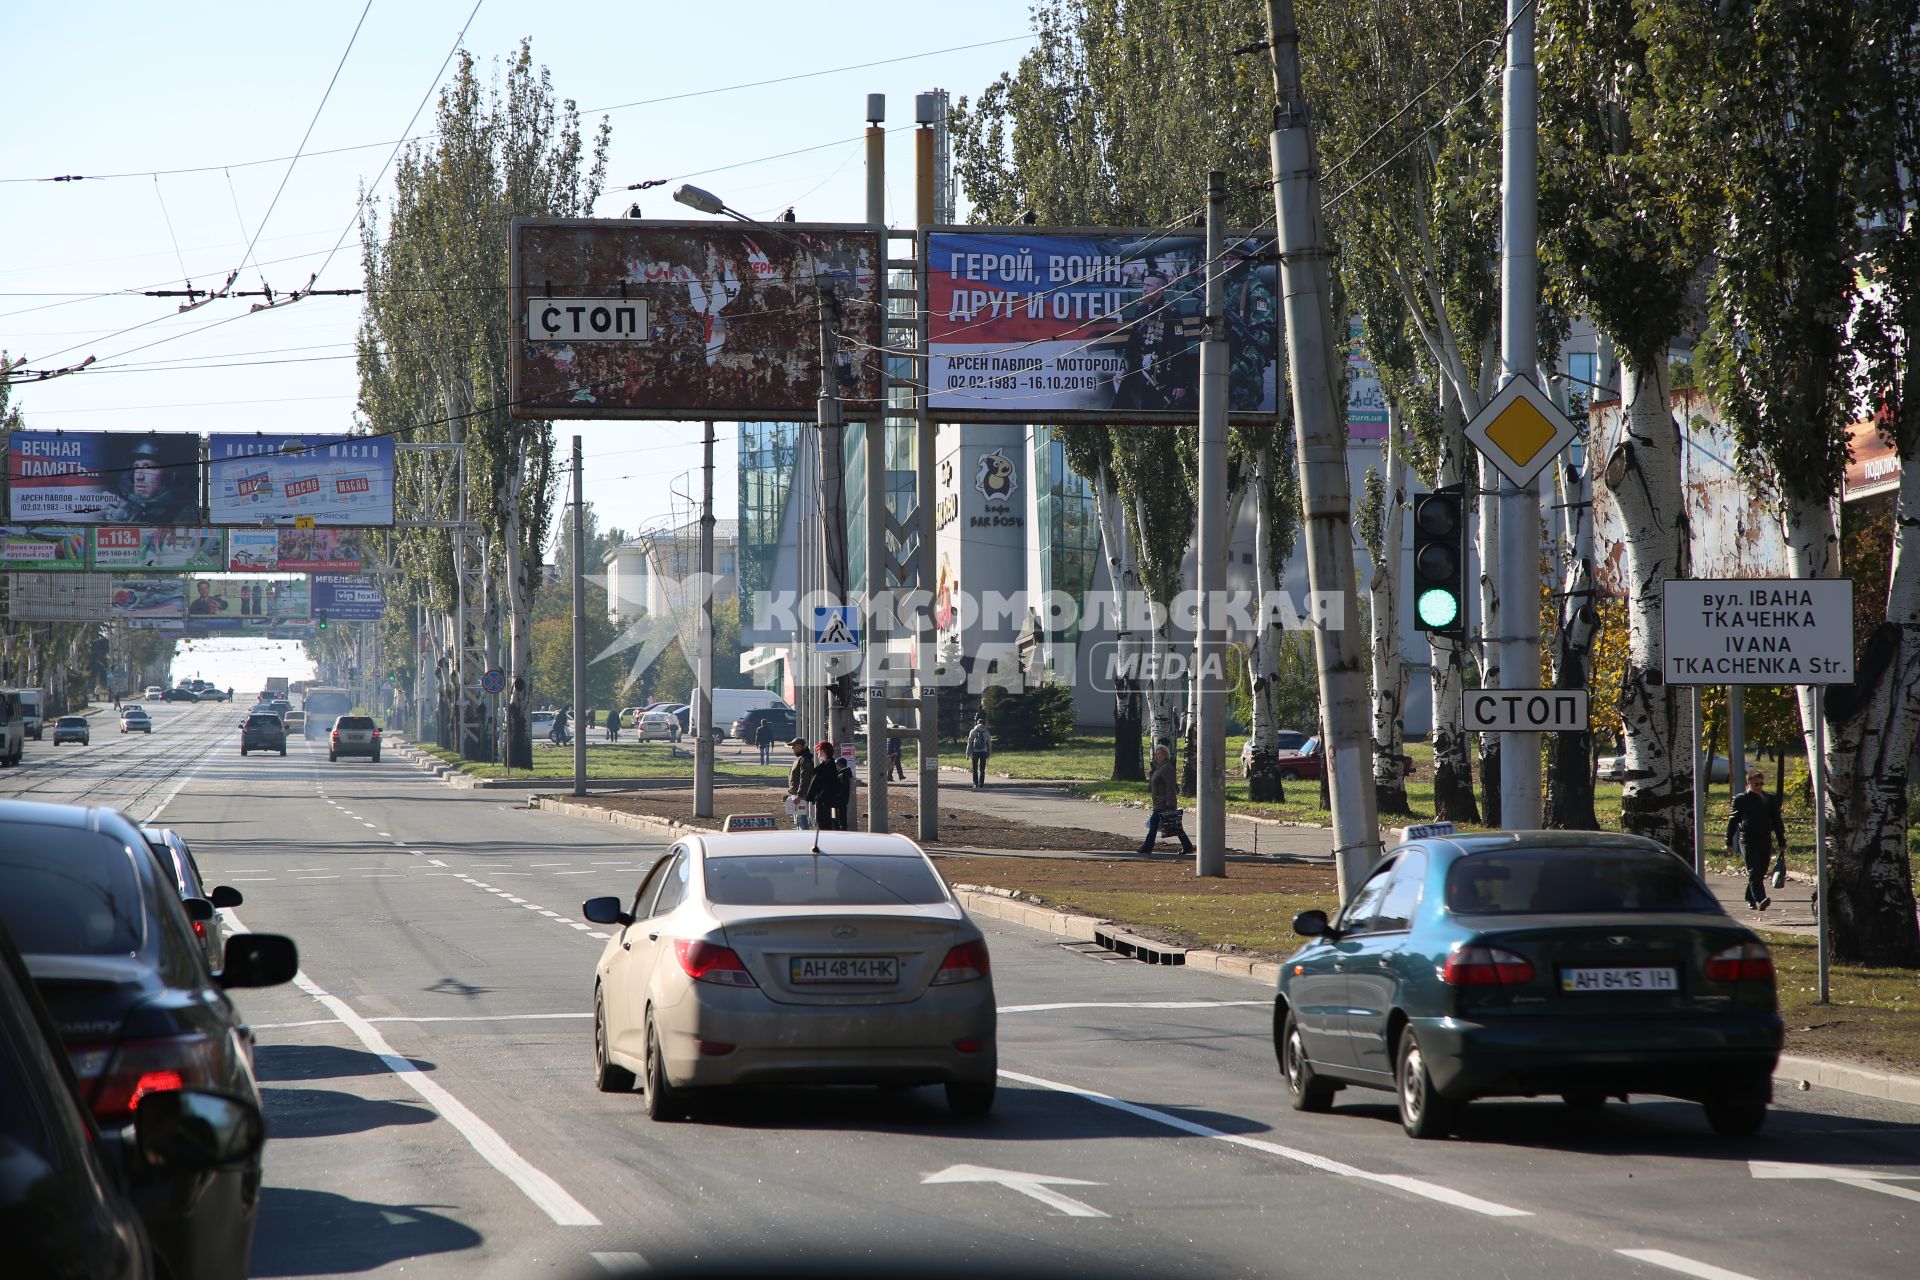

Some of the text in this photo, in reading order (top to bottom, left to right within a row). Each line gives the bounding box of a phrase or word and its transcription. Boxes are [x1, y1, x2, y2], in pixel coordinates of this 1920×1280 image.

[951, 248, 1128, 286] ГЕРОЙ, ВОИН,
[949, 289, 1123, 323] ДРУГ И ОТЕЦ
[541, 306, 636, 333] СТОП
[948, 358, 988, 372] АРСЕН
[991, 358, 1043, 372] ПАВЛОВ
[1057, 358, 1128, 373] МОТОРОЛА
[948, 376, 1017, 391] (02.02.1983
[22, 441, 81, 457] ВЕЧНАЯ
[329, 445, 379, 458] МАСЛО
[22, 461, 99, 477] ПАМЯТЬ...
[287, 478, 318, 497] МАСЛО
[338, 478, 367, 493] МАСЛО
[21, 494, 43, 502] АРСЕН
[45, 494, 72, 502] ПАВЛОВ
[79, 494, 118, 502] МОТОРОЛА
[99, 537, 109, 545] от
[110, 530, 131, 545] 113
[338, 591, 354, 601] vip
[1703, 590, 1813, 608] вул. ІВАНА
[1702, 611, 1816, 627] ТКАЧЕНКА
[1726, 637, 1791, 653] IVANA
[1673, 658, 1847, 674] TKACHENKA Str.
[1474, 696, 1577, 725] СТОП
[804, 961, 892, 977] AH 4814 HK
[1576, 968, 1673, 988] AH 8415 IH
